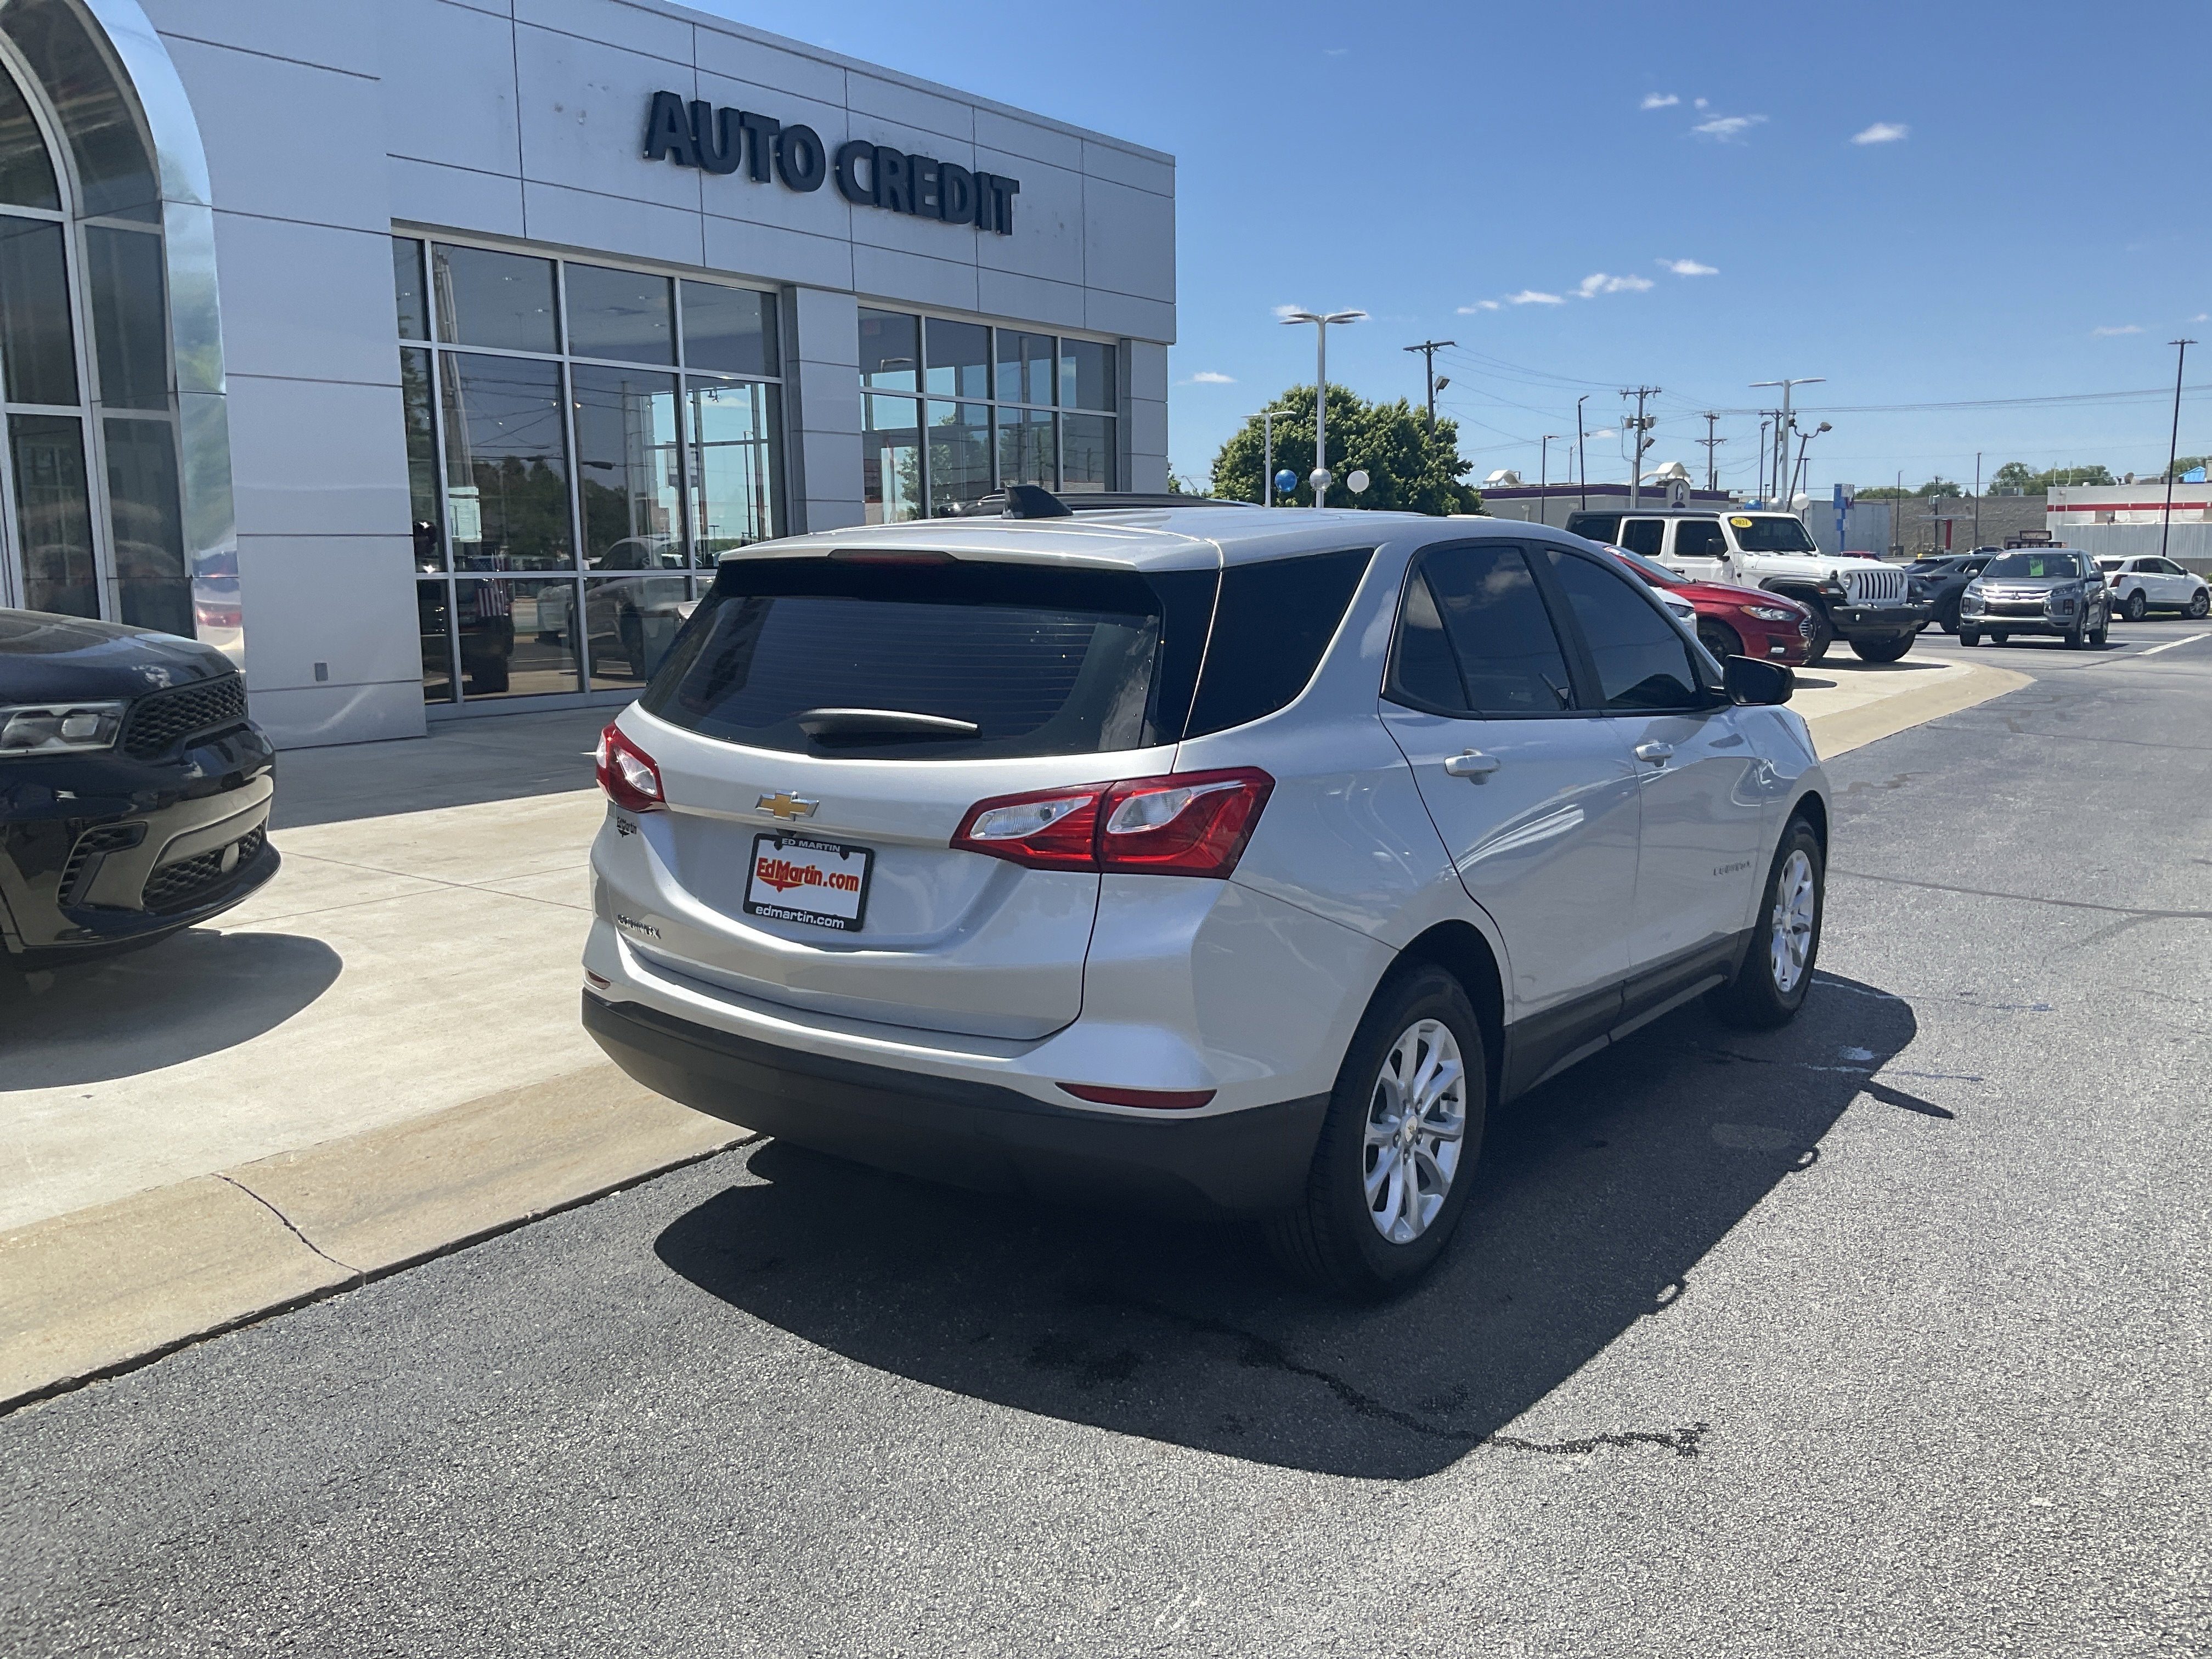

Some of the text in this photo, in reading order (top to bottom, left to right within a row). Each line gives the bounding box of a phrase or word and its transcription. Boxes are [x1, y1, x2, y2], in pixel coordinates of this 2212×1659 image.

[643, 90, 1020, 236] AUTO CREDIT
[799, 840, 840, 852] MARTIN
[757, 857, 859, 891] EdMartin.com
[755, 905, 844, 929] edmartin.com
